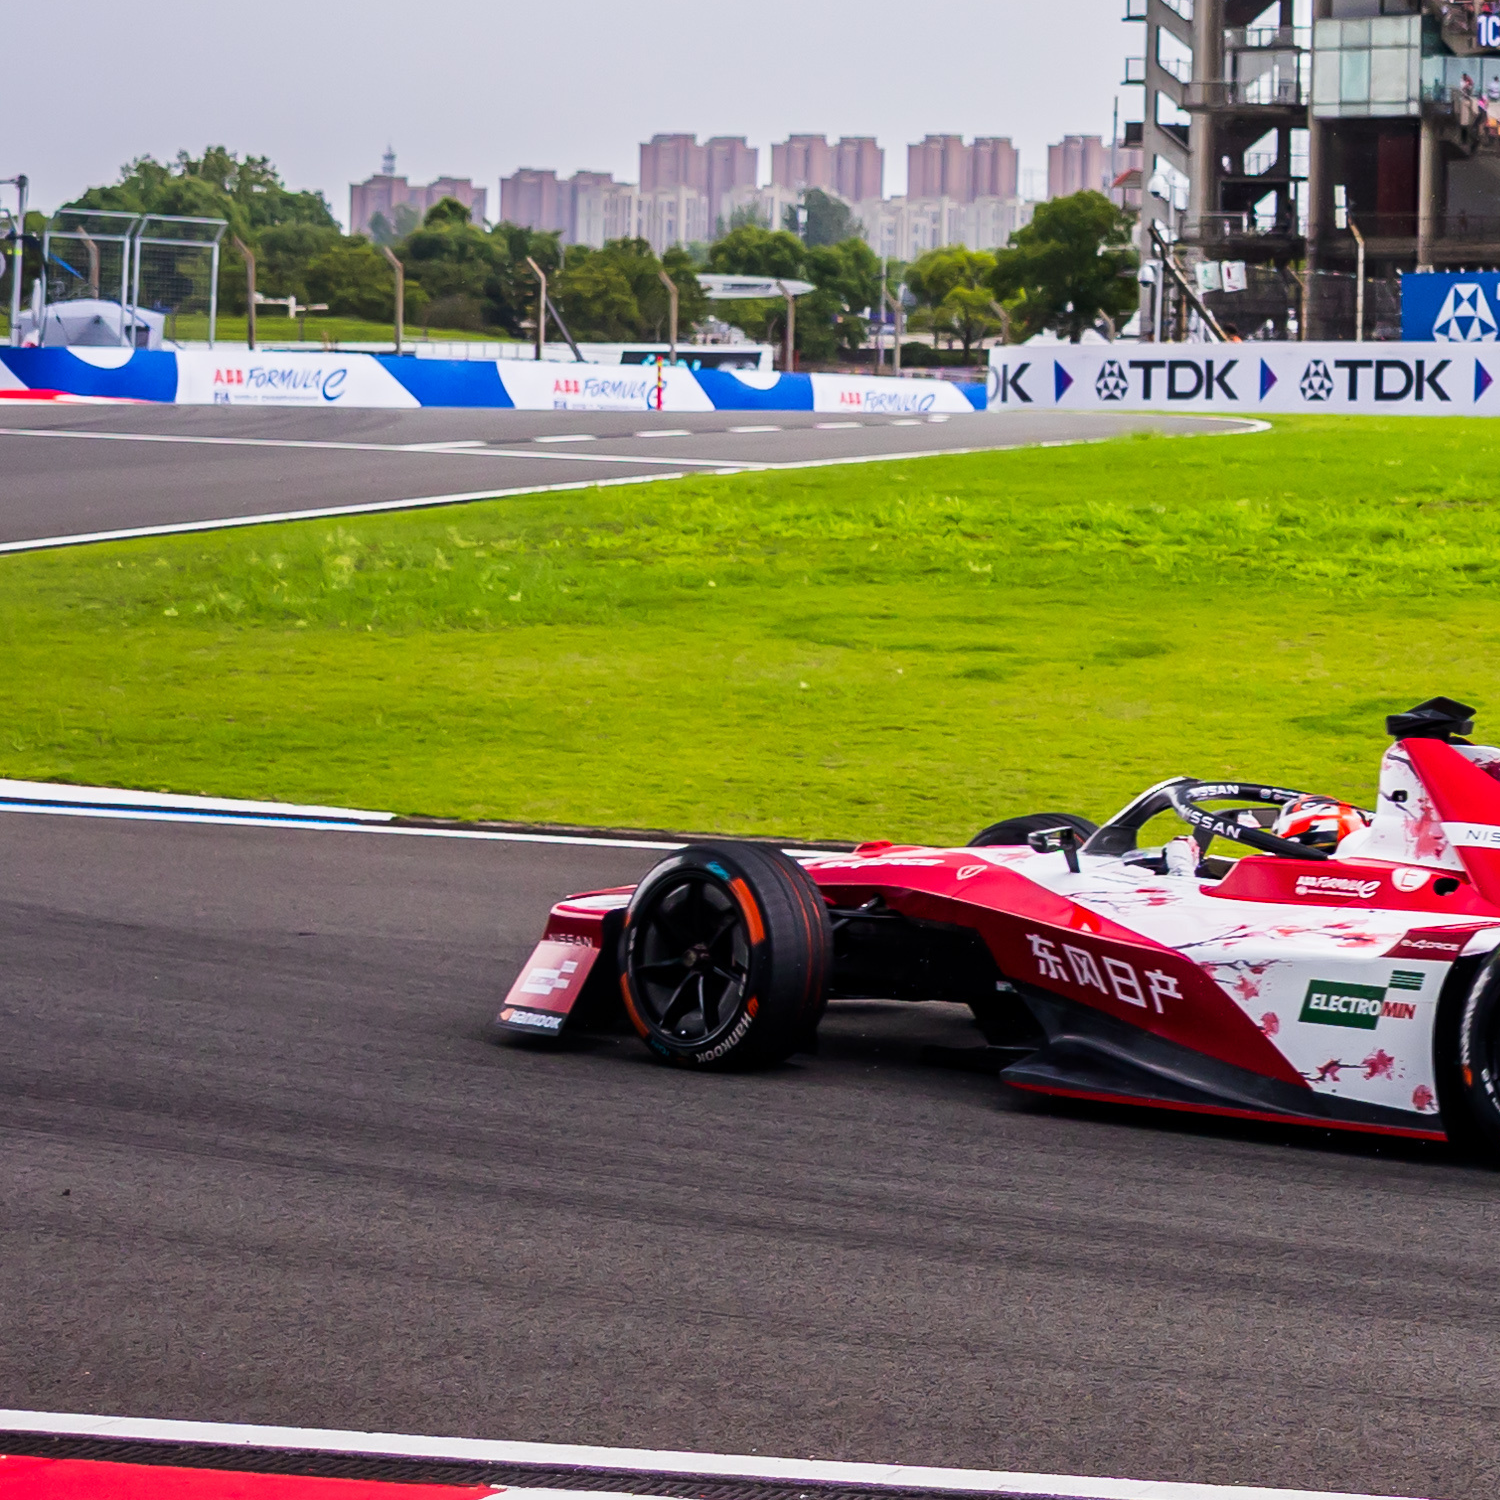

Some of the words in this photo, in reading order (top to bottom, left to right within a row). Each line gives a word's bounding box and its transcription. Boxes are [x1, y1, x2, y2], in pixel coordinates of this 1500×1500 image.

[1478, 15, 1500, 47] 1C
[1128, 359, 1240, 401] TDK
[1334, 359, 1452, 402] TDK
[1025, 934, 1184, 1014] 东风日产
